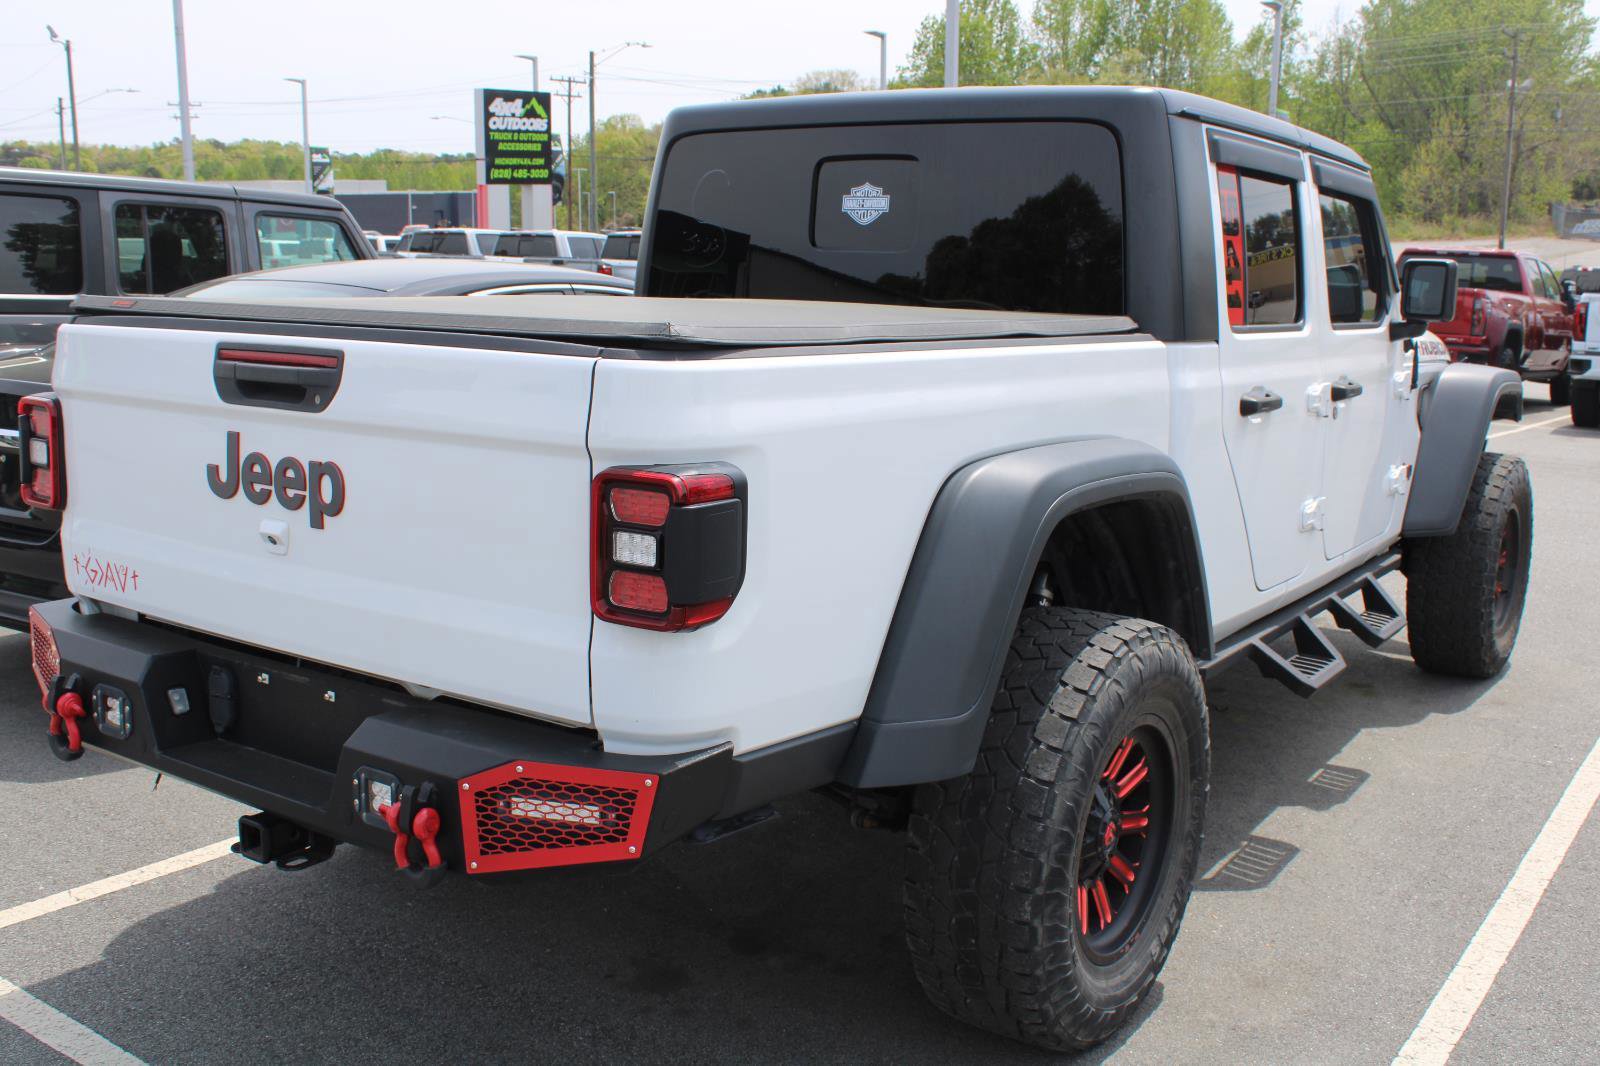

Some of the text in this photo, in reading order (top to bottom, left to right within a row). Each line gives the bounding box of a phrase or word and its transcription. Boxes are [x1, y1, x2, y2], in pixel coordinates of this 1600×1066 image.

[488, 116, 548, 131] OUTDOORS
[489, 132, 512, 140] TRUCK
[519, 132, 548, 141] OUTDOOR
[498, 142, 542, 151] ACCESSORIES
[845, 199, 886, 208] HARLEY-DAVIDSON
[207, 430, 345, 530] Jeep
